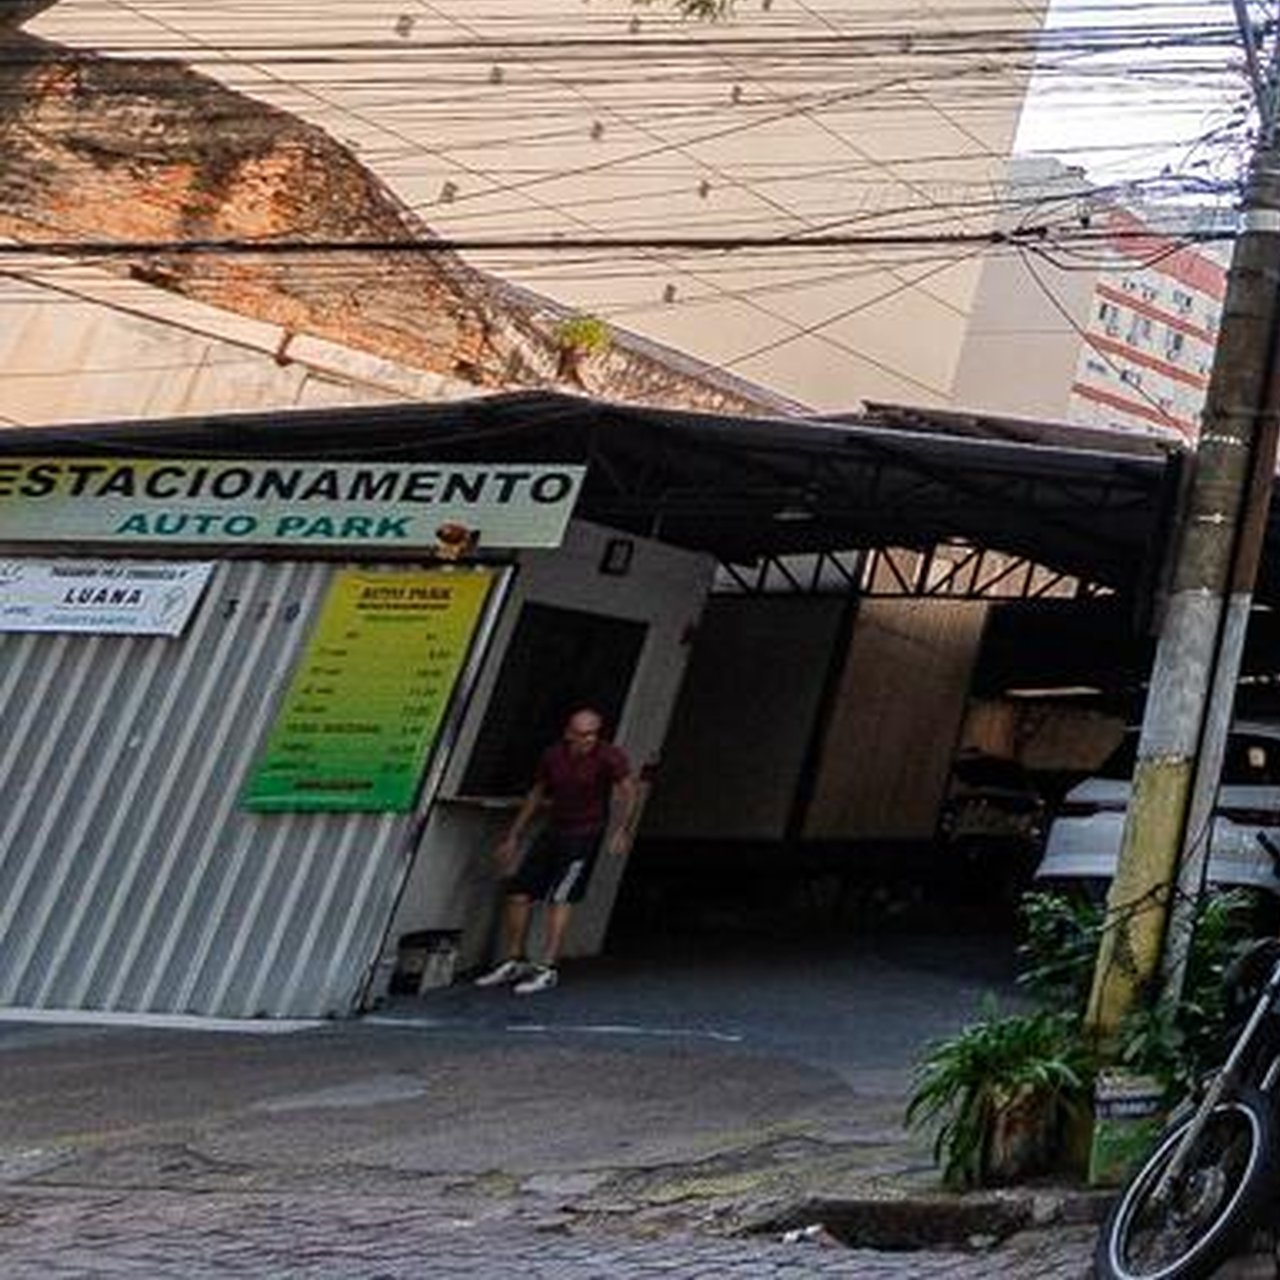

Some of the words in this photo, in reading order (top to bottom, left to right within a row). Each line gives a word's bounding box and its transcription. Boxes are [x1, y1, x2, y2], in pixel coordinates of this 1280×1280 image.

[0, 464, 573, 504] ESTACIONAMENTO
[115, 514, 258, 536] AUTO
[275, 516, 412, 539] PARK
[63, 588, 143, 605] LUANA
